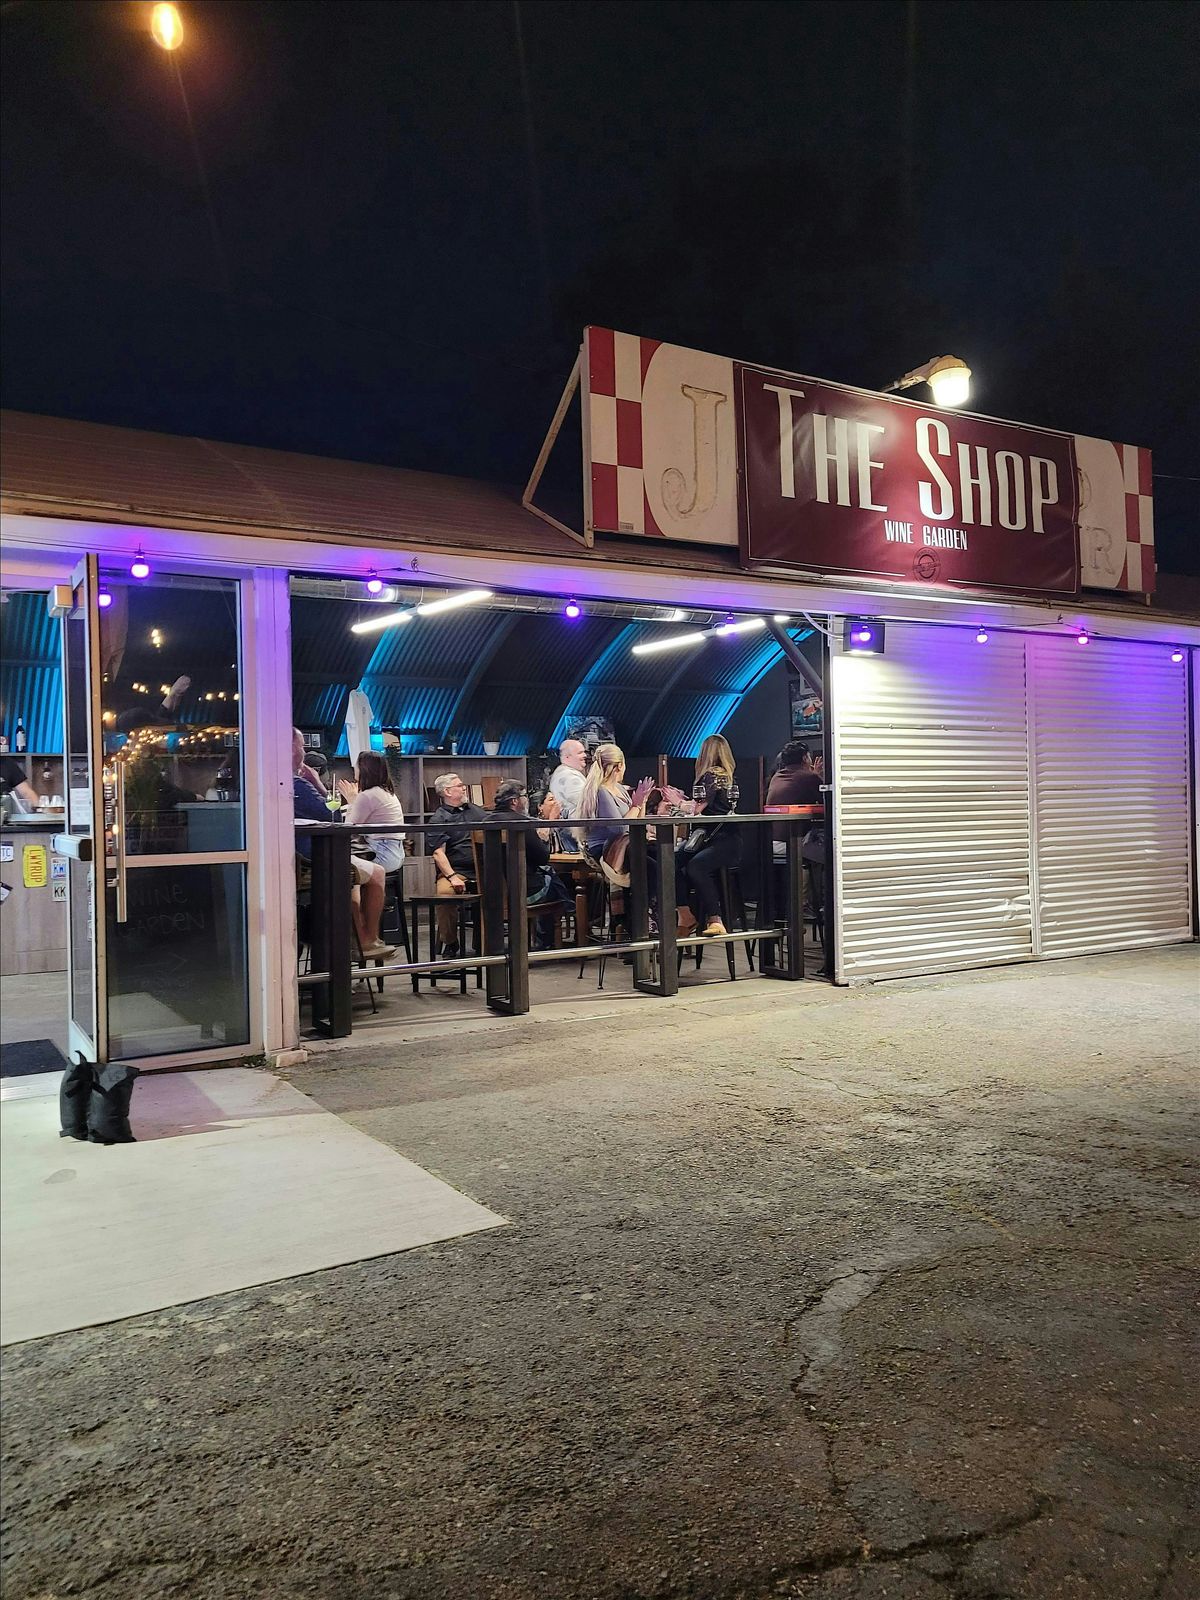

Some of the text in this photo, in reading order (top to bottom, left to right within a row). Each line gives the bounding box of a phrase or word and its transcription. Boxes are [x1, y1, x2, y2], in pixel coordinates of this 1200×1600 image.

[763, 383, 1059, 534] THE SHOP
[884, 519, 968, 551] WINE GARDEN
